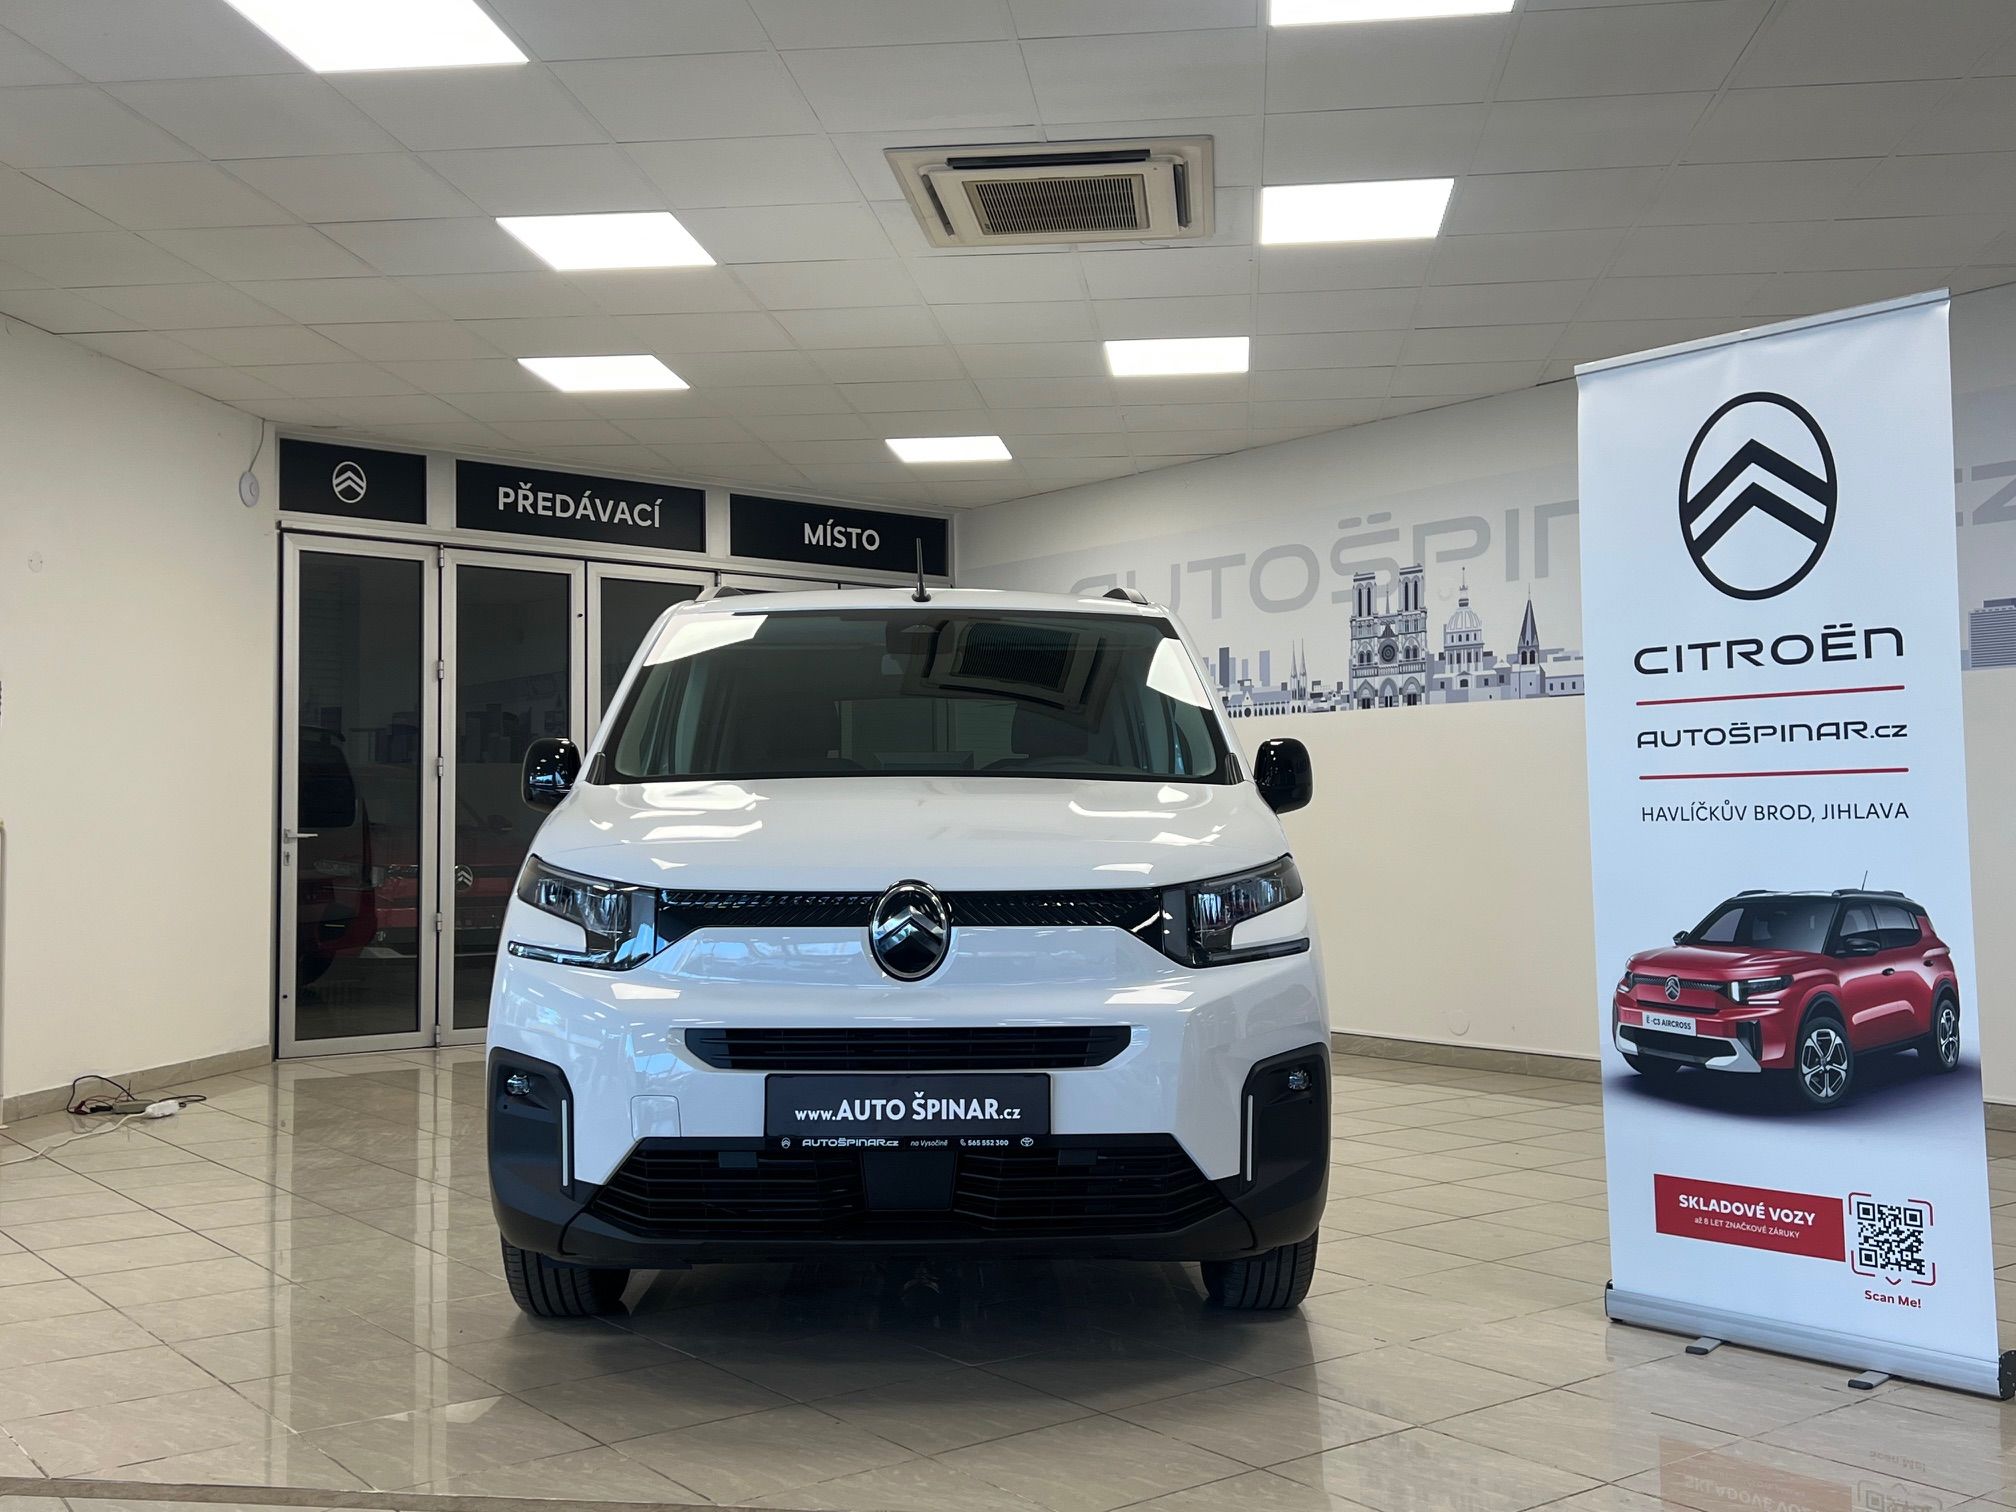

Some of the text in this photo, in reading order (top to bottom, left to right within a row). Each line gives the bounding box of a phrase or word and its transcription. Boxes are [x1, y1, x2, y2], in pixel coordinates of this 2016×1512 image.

[498, 481, 880, 552] PŘEDÁVACÍ MÍSTO
[1634, 622, 1905, 675] CITROËN
[1642, 800, 1910, 823] HAVLÍČKŮV BROD, JIHLAVA
[1662, 1018, 1692, 1030] AIRCROSS
[912, 1091, 1021, 1120] ŠPINAR.cz
[1678, 1194, 1816, 1226] SKLADOVÉ VOZY
[1694, 1216, 1703, 1225] až
[1710, 1219, 1723, 1228] LET
[1725, 1222, 1767, 1235] ZNAČKOVÉ
[1768, 1227, 1800, 1239] ZÁRUKY
[1864, 1290, 1922, 1309] Scan Me!
